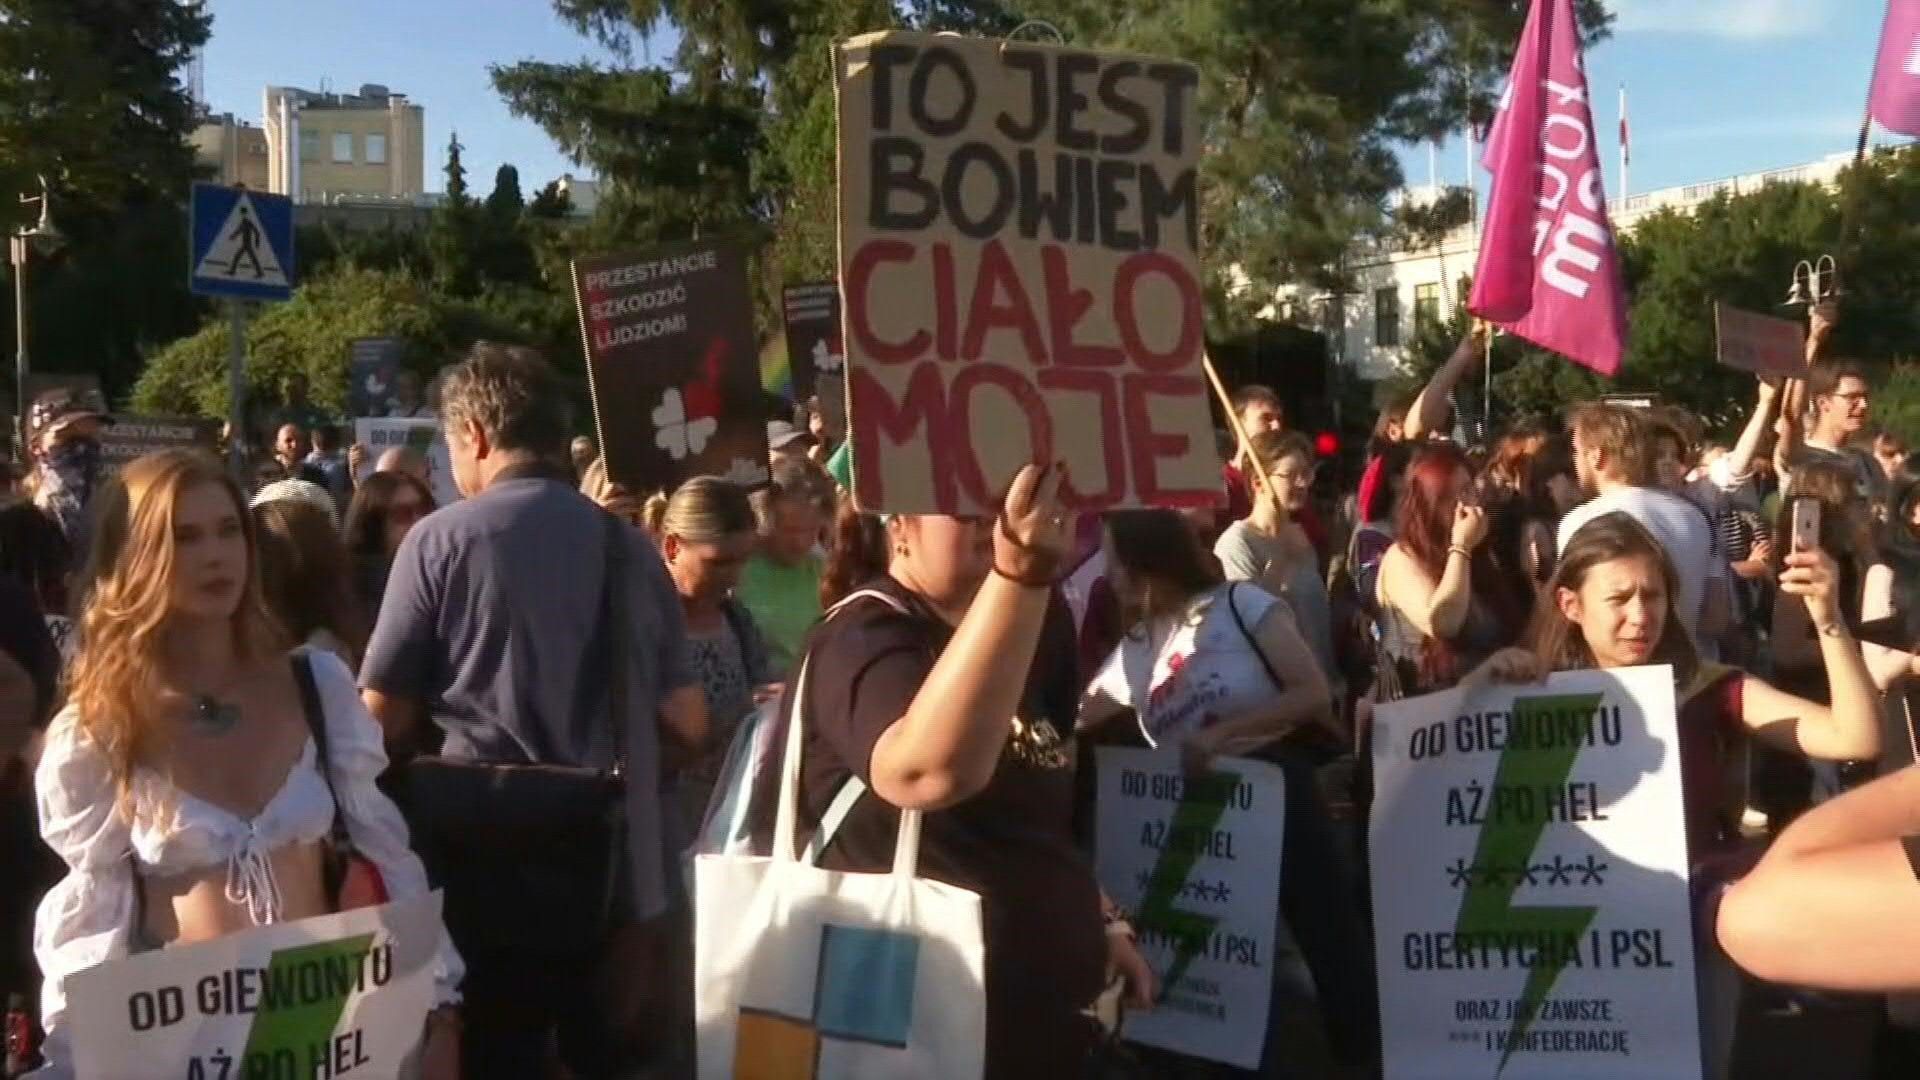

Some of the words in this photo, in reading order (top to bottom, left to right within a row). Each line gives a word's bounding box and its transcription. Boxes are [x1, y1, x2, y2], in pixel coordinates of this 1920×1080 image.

[870, 44, 976, 136] TO
[995, 49, 1198, 155] JEST
[869, 137, 1199, 252] BOWIEM
[590, 280, 687, 320] SZKODZIĆ
[848, 239, 1203, 372] CIAŁO
[854, 361, 1226, 513] MOJE
[1409, 721, 1446, 761] OD
[1454, 705, 1622, 752] GIEWONTU
[1446, 779, 1486, 825] AŻ
[1495, 784, 1534, 823] PO
[1545, 782, 1609, 821] HEL
[1226, 935, 1263, 968] PSL
[1403, 930, 1583, 971] GIERTYCHA
[1592, 930, 1601, 969] I
[1611, 928, 1674, 969] PSL
[128, 985, 185, 1031] OD
[195, 943, 394, 1017] GIEWONTU
[1456, 999, 1500, 1022] ORAZ
[1542, 999, 1614, 1022] ZAWSZE
[186, 1046, 232, 1080] AŻ
[308, 1027, 371, 1080] HEL
